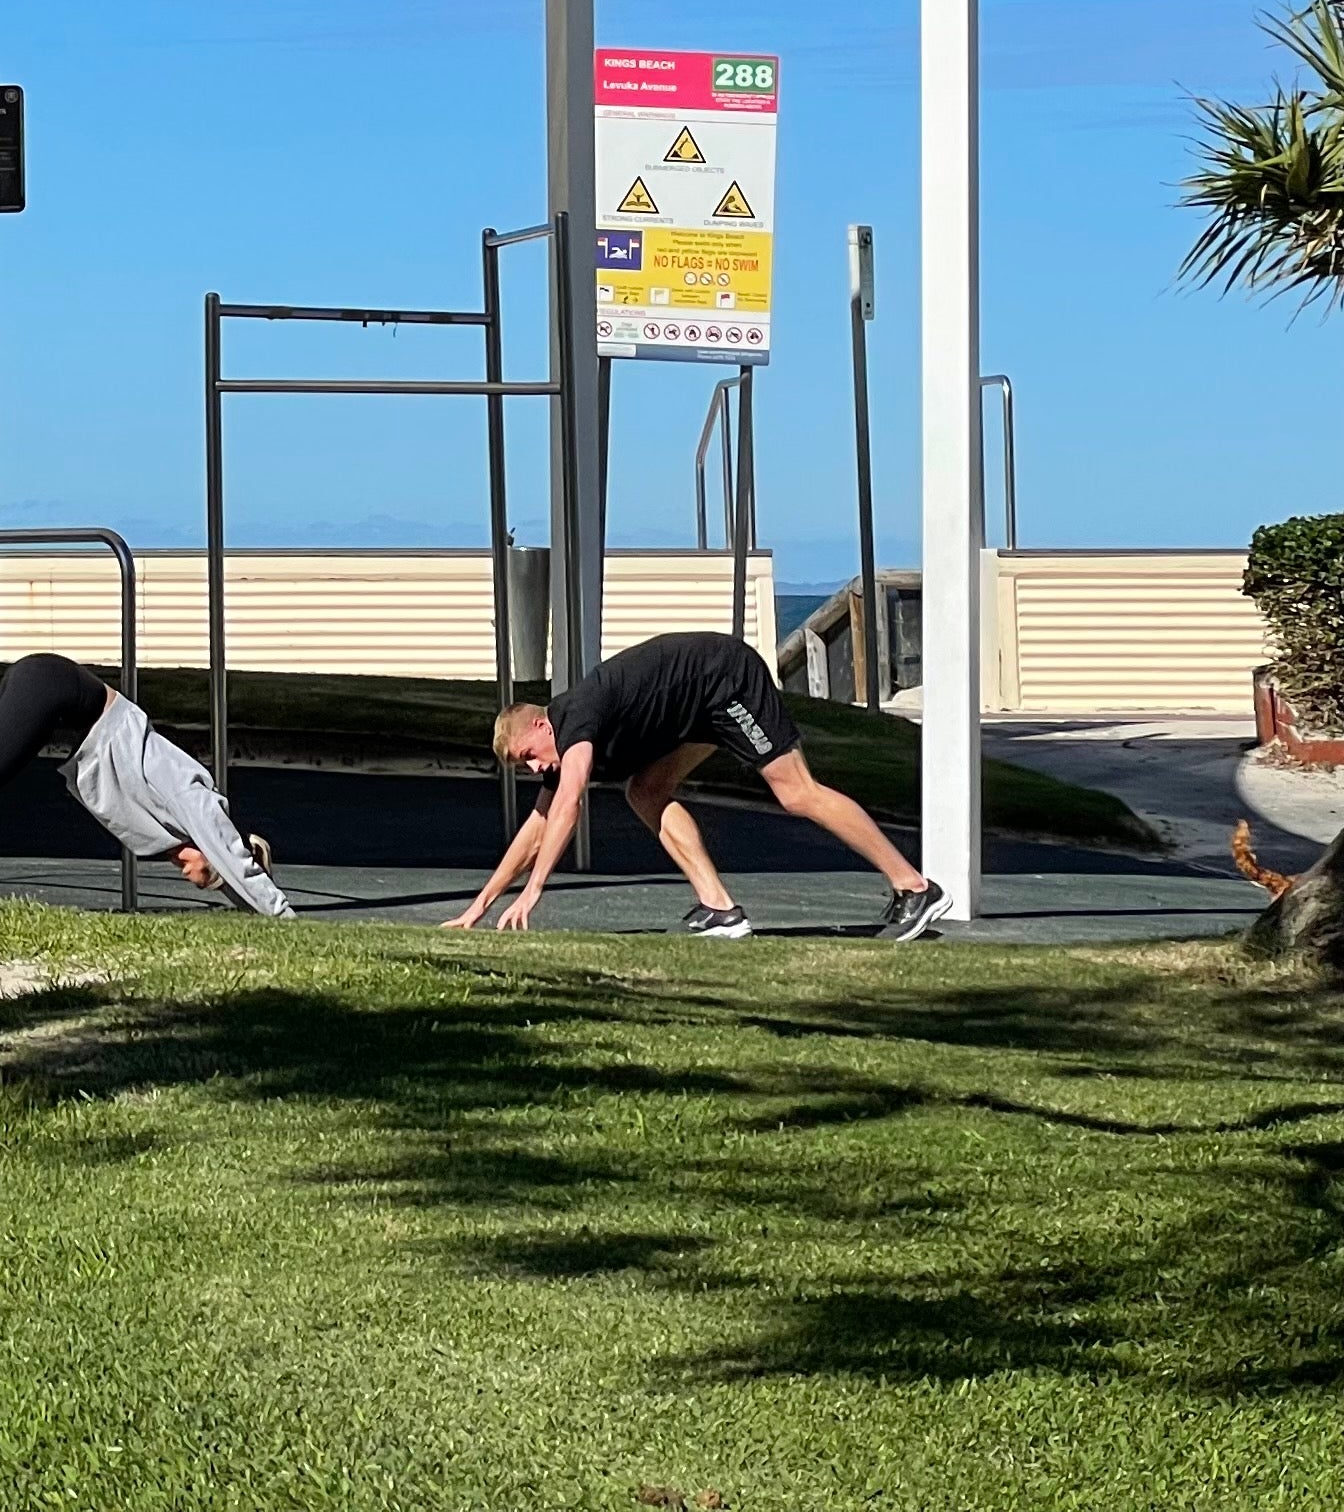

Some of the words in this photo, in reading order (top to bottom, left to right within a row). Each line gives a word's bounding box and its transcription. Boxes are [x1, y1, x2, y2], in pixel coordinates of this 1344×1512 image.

[604, 58, 636, 68] KINGS
[639, 59, 675, 70] BEACH
[716, 63, 773, 88] 288
[603, 80, 638, 91] Levuka
[640, 81, 677, 92] Avenue
[653, 255, 668, 268] NO
[671, 256, 704, 269] FLAGS
[715, 258, 730, 270] NO
[732, 259, 759, 272] SWIM
